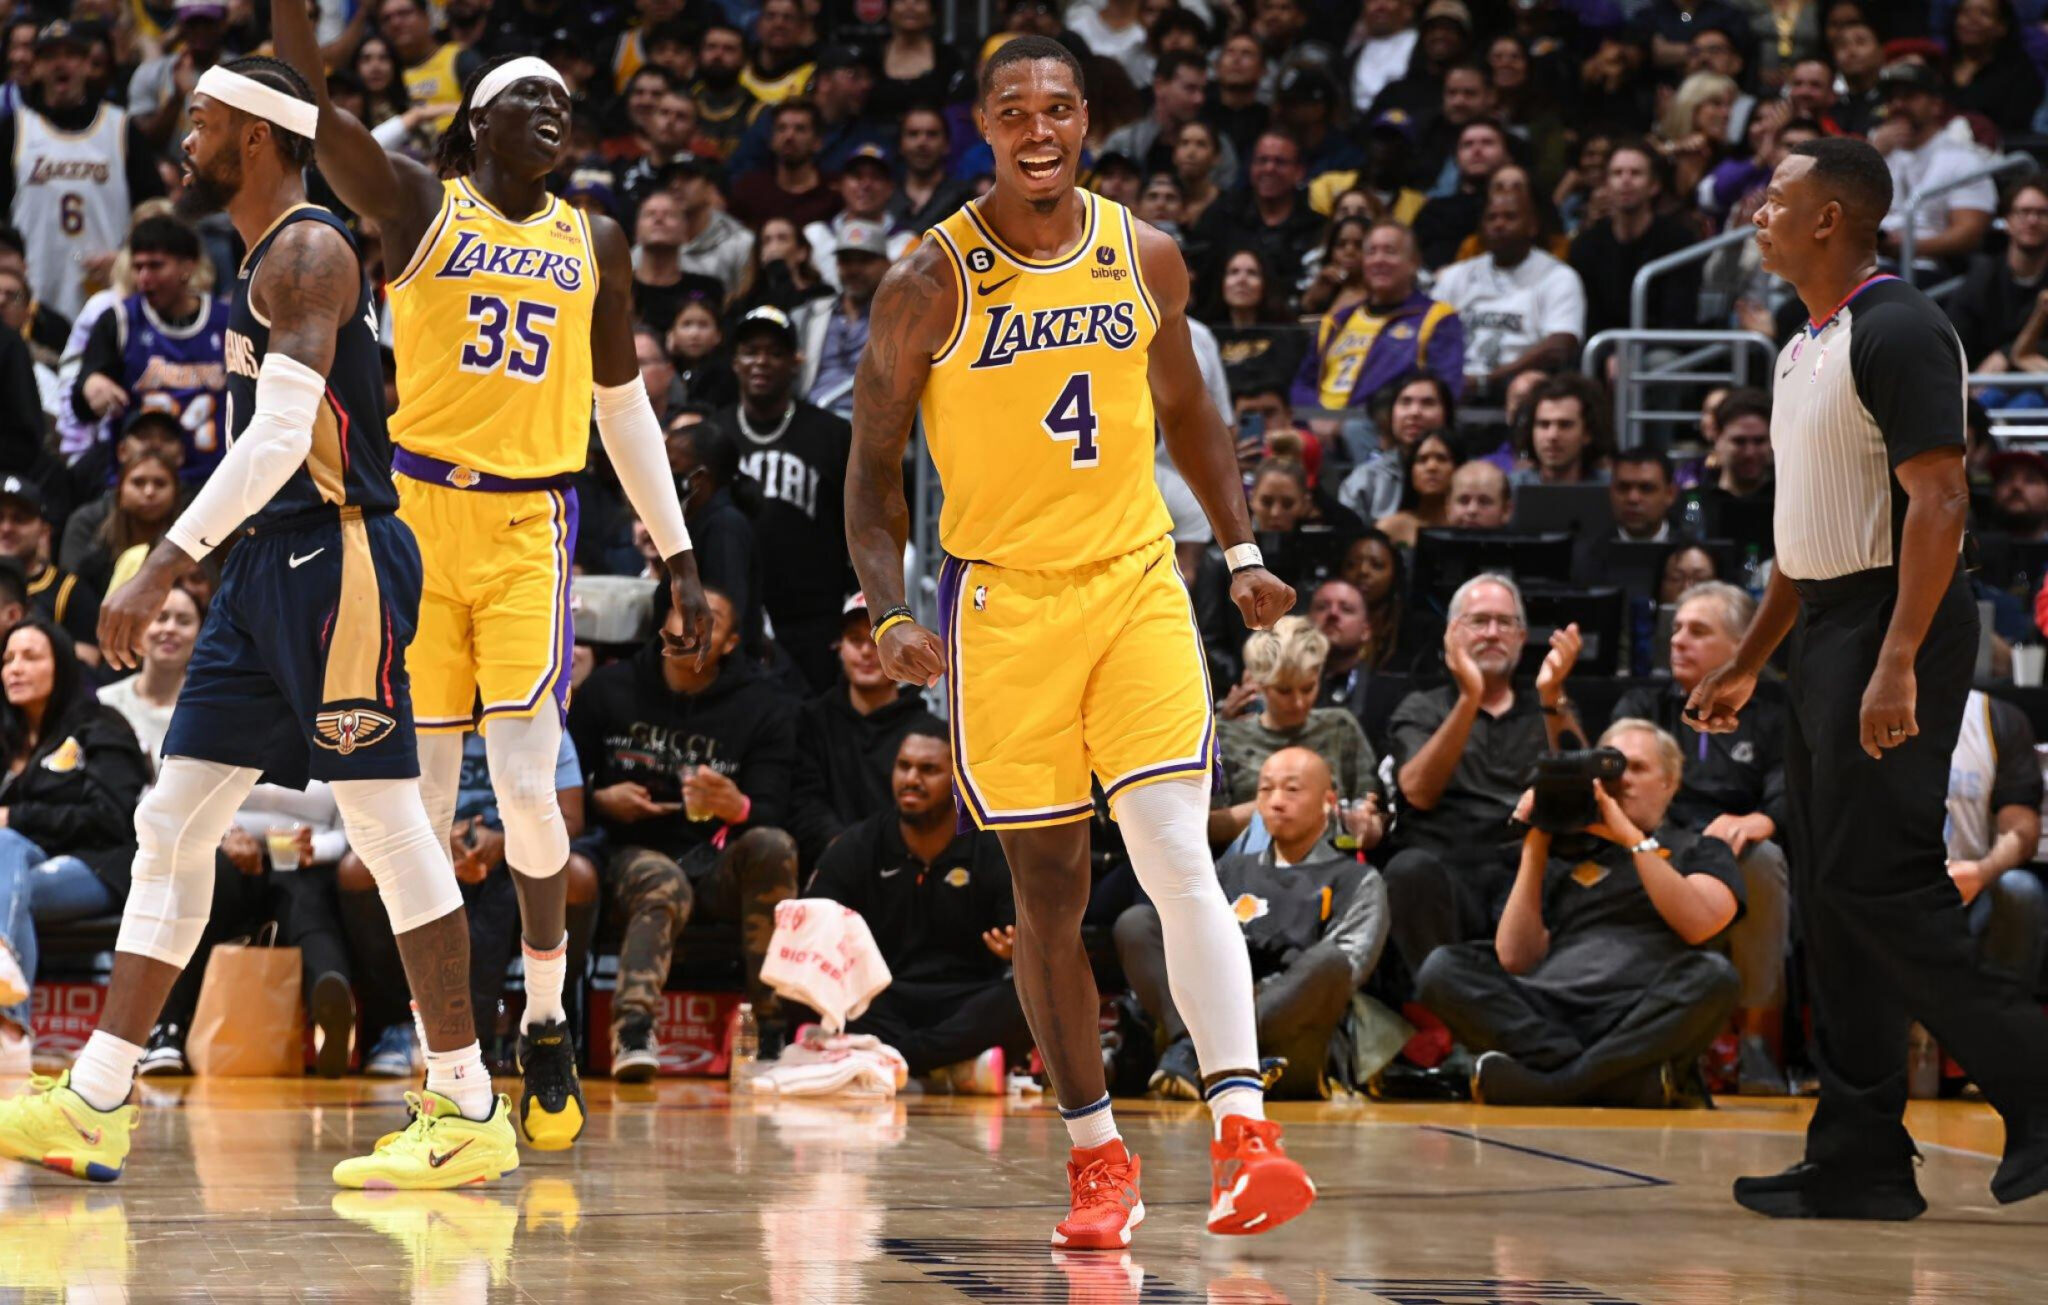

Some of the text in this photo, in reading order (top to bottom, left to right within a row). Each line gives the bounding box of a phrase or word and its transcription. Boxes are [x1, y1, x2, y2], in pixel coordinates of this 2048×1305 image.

[61, 193, 83, 235] 6
[434, 230, 582, 292] LAKERS
[972, 250, 990, 270] 6
[1091, 268, 1127, 281] bibigo
[459, 293, 559, 384] 35
[969, 301, 1138, 370] LAKERS
[1040, 371, 1099, 469] 4
[629, 721, 715, 759] GUCCI
